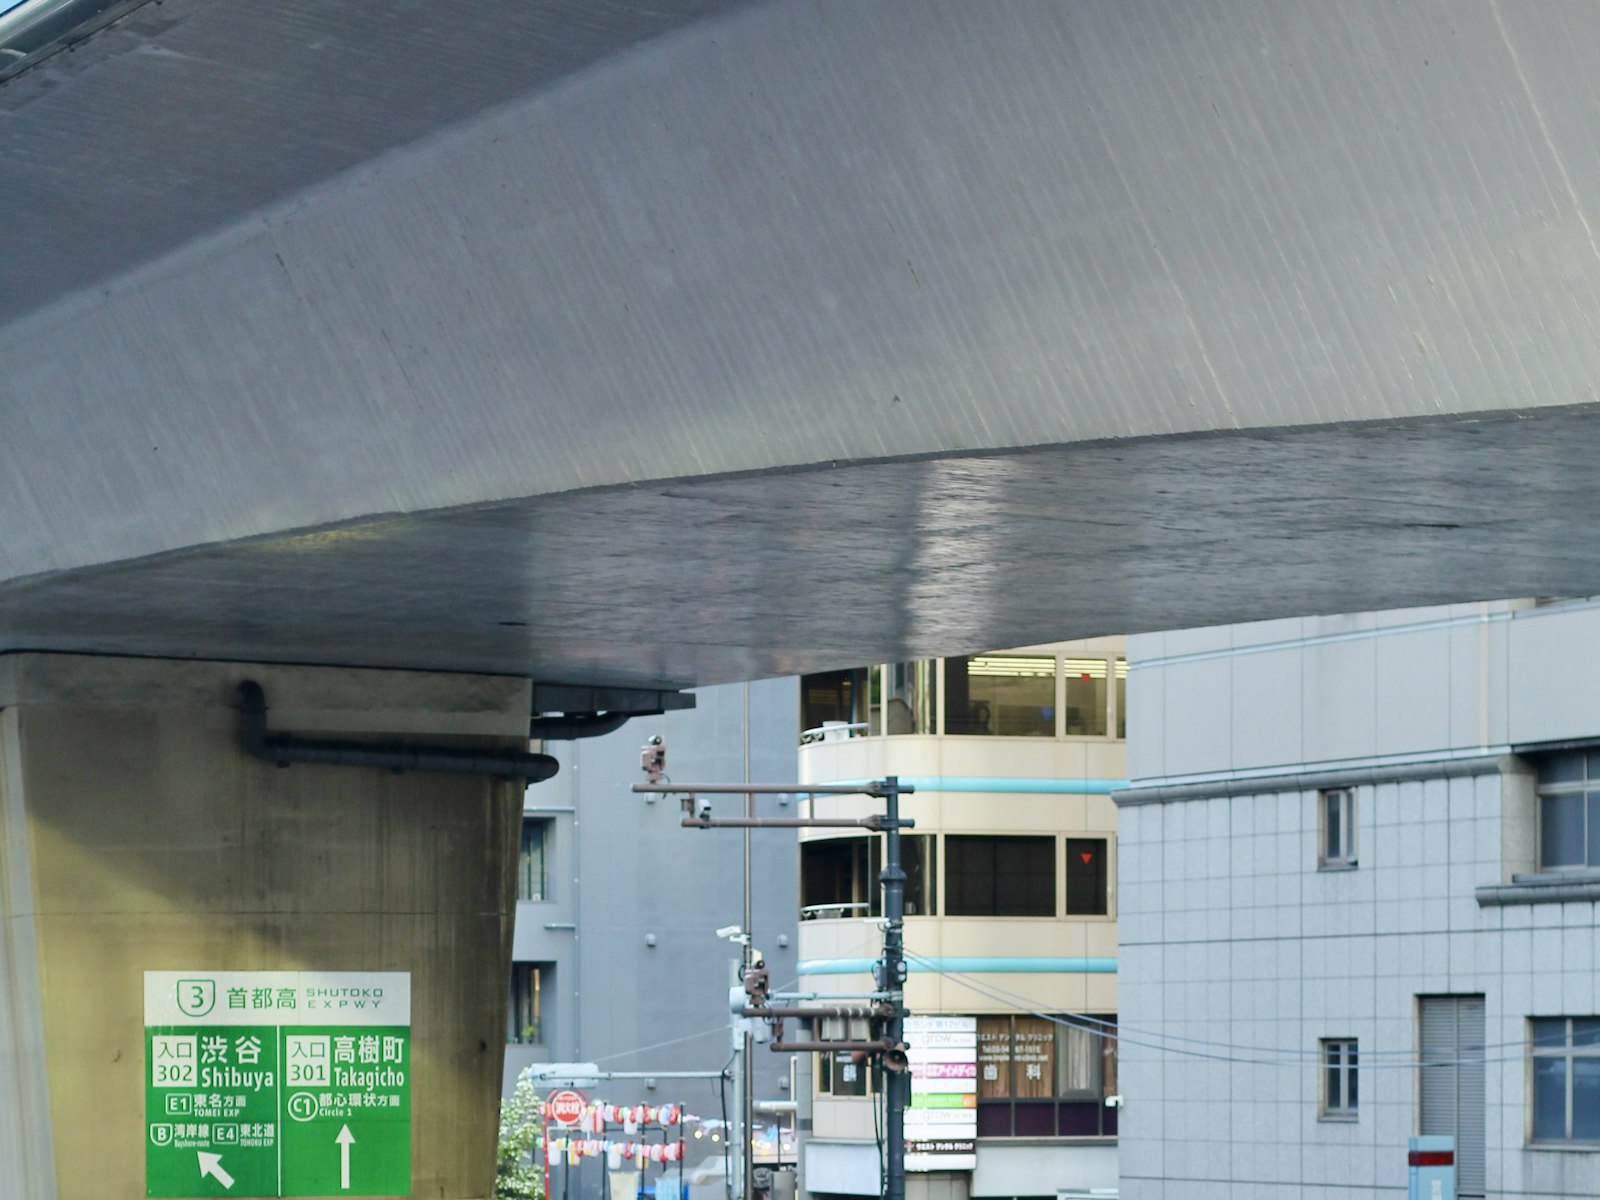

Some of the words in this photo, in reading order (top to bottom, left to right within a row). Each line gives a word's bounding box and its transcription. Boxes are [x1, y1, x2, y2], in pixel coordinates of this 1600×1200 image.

[190, 985, 205, 1009] 3
[226, 987, 297, 1009] 首都高
[306, 988, 384, 997] SHUTOKO
[158, 1041, 193, 1059] 入口
[201, 1035, 262, 1065] 渋谷
[291, 1041, 326, 1059] 入口
[333, 1035, 405, 1064] 高樹町
[157, 1065, 193, 1082] 302
[201, 1066, 274, 1092] Shibuya
[291, 1064, 327, 1082] 301
[333, 1066, 405, 1092] Takagicho
[170, 1097, 188, 1111] E1
[193, 1094, 247, 1108] 東名方面
[293, 1098, 311, 1116] C1
[319, 1093, 400, 1108] 都心環状方面
[194, 1109, 221, 1117] TOMEI
[223, 1109, 240, 1117] EXP
[319, 1108, 344, 1116] Circle
[157, 1127, 167, 1141] B
[174, 1124, 209, 1138] 湾岸線
[216, 1127, 235, 1141] E4
[240, 1124, 275, 1138] 東北道
